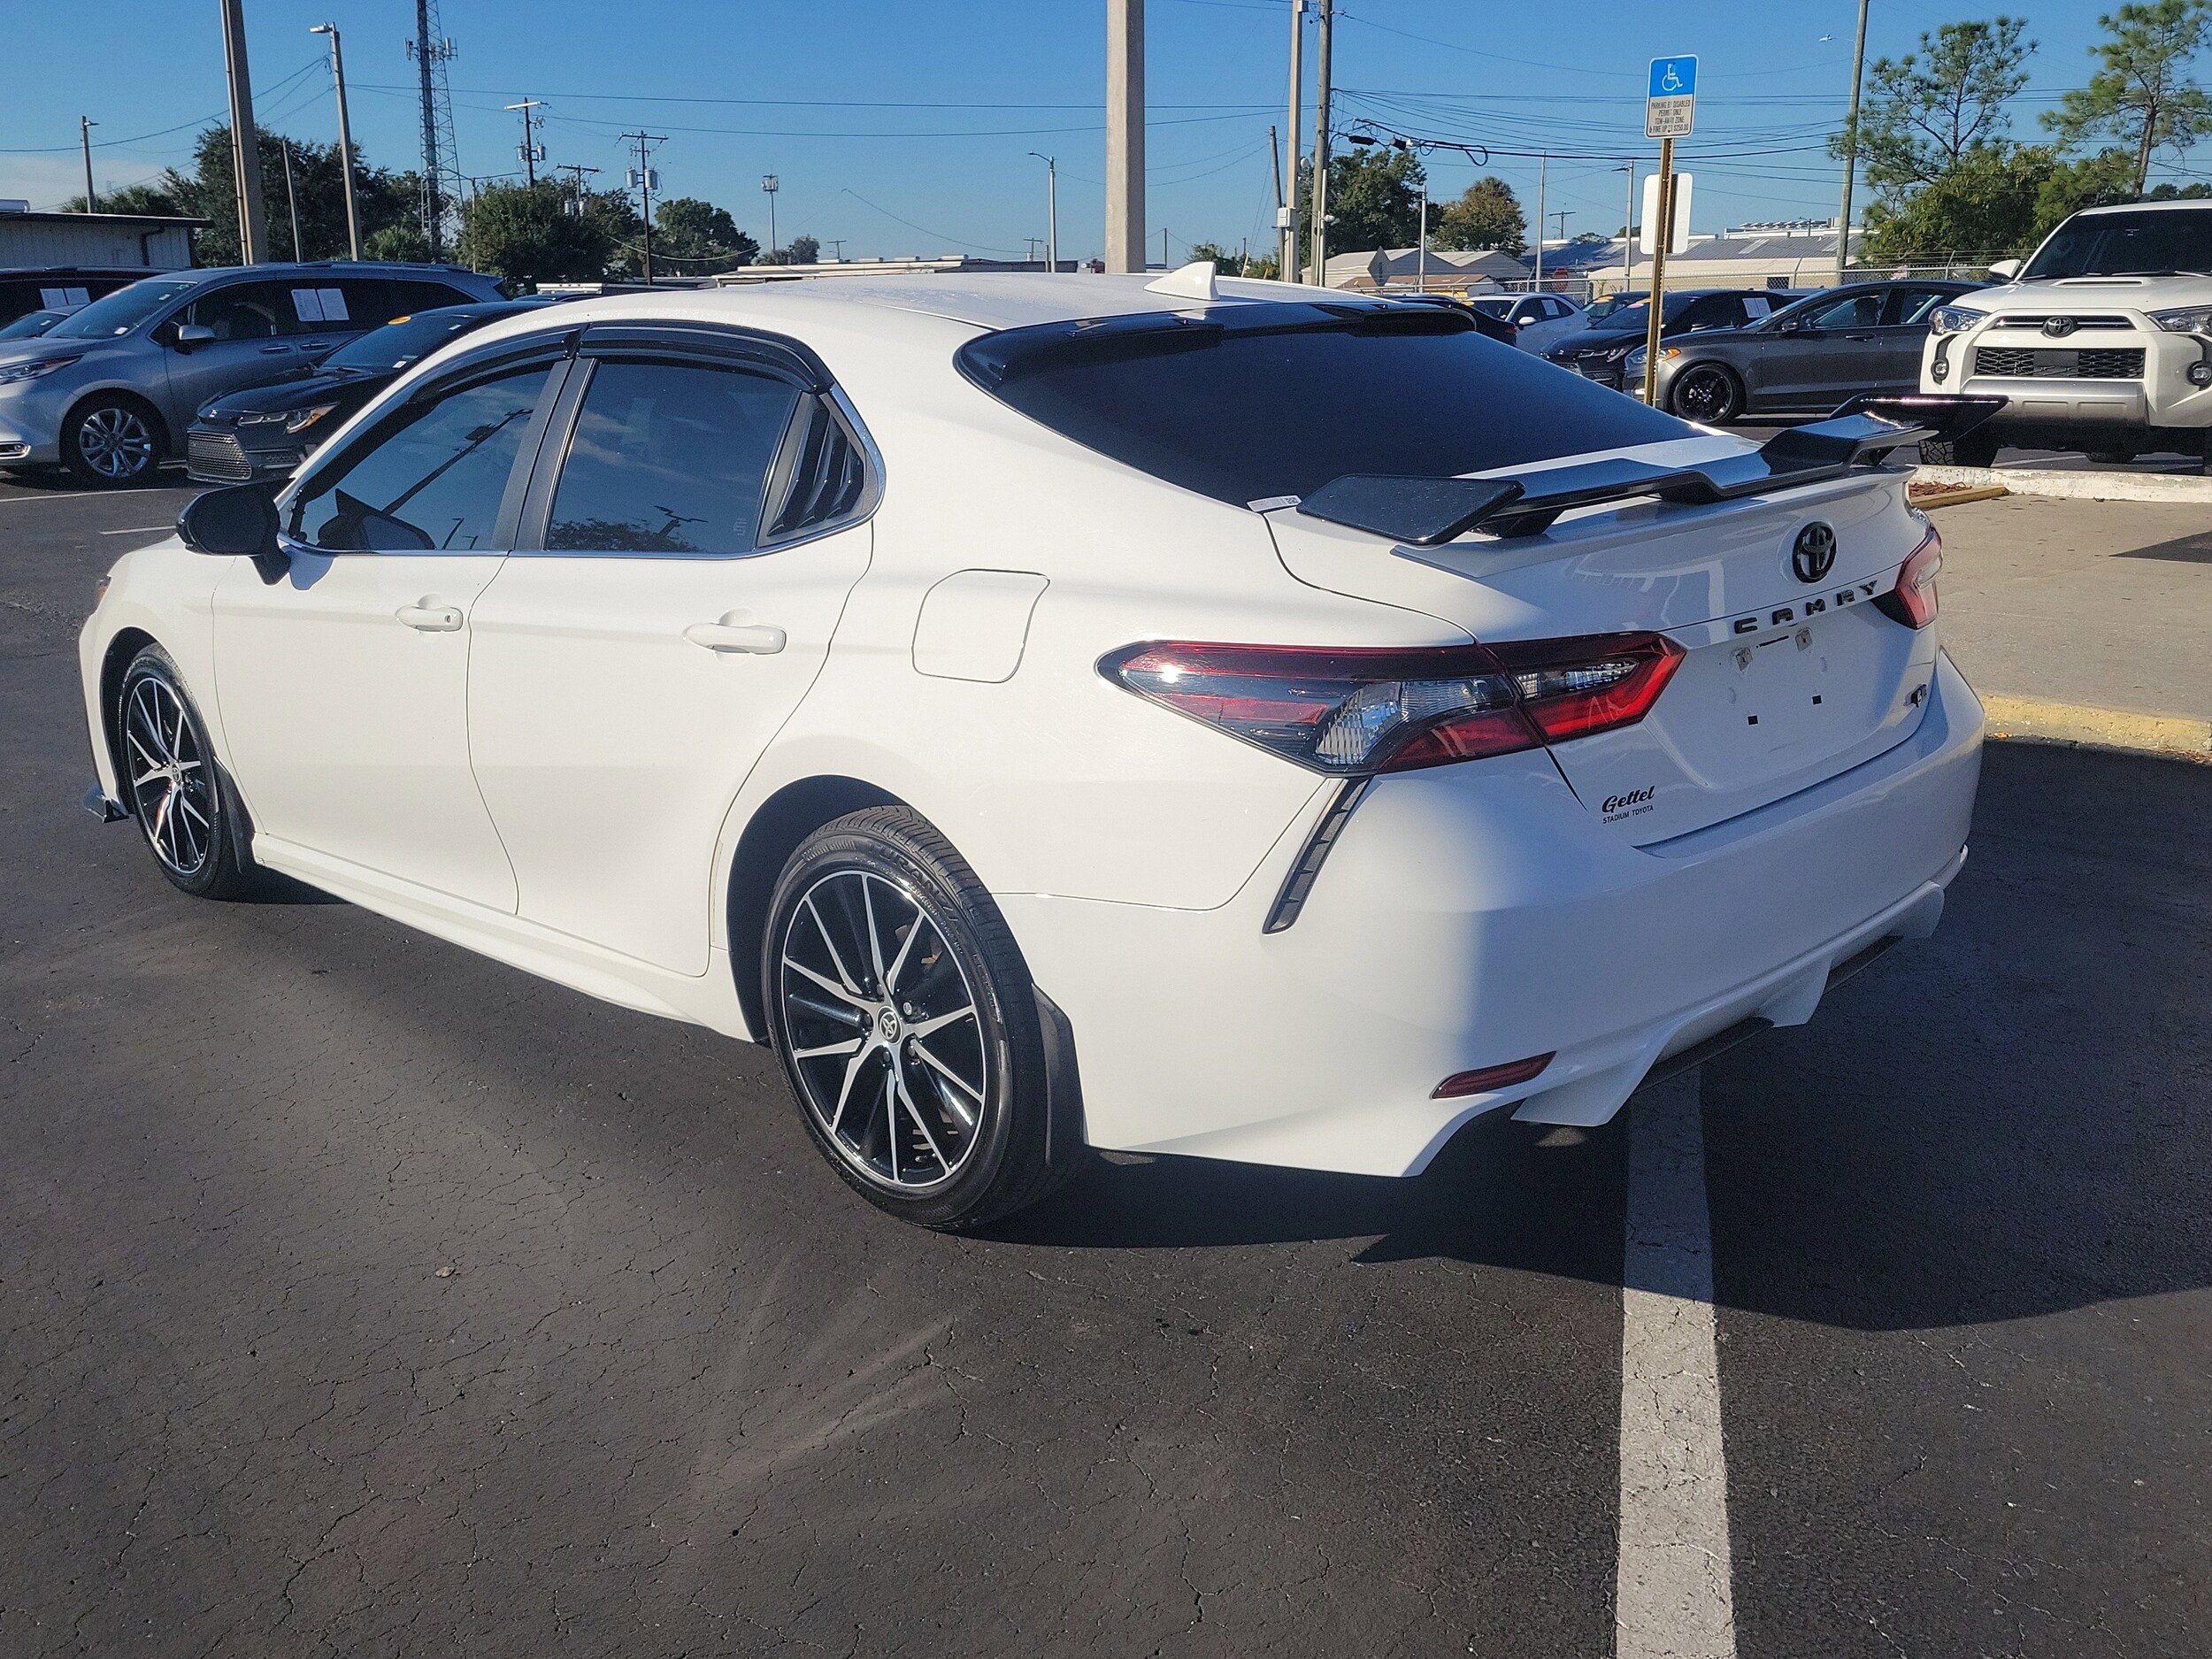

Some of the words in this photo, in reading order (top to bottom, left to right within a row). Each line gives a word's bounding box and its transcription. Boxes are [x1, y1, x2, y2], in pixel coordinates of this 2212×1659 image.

[1733, 580, 1878, 634] CAMRY
[1601, 785, 1655, 813] Gettel
[1602, 811, 1630, 824] STADIUM
[1632, 805, 1654, 816] TOYOTA
